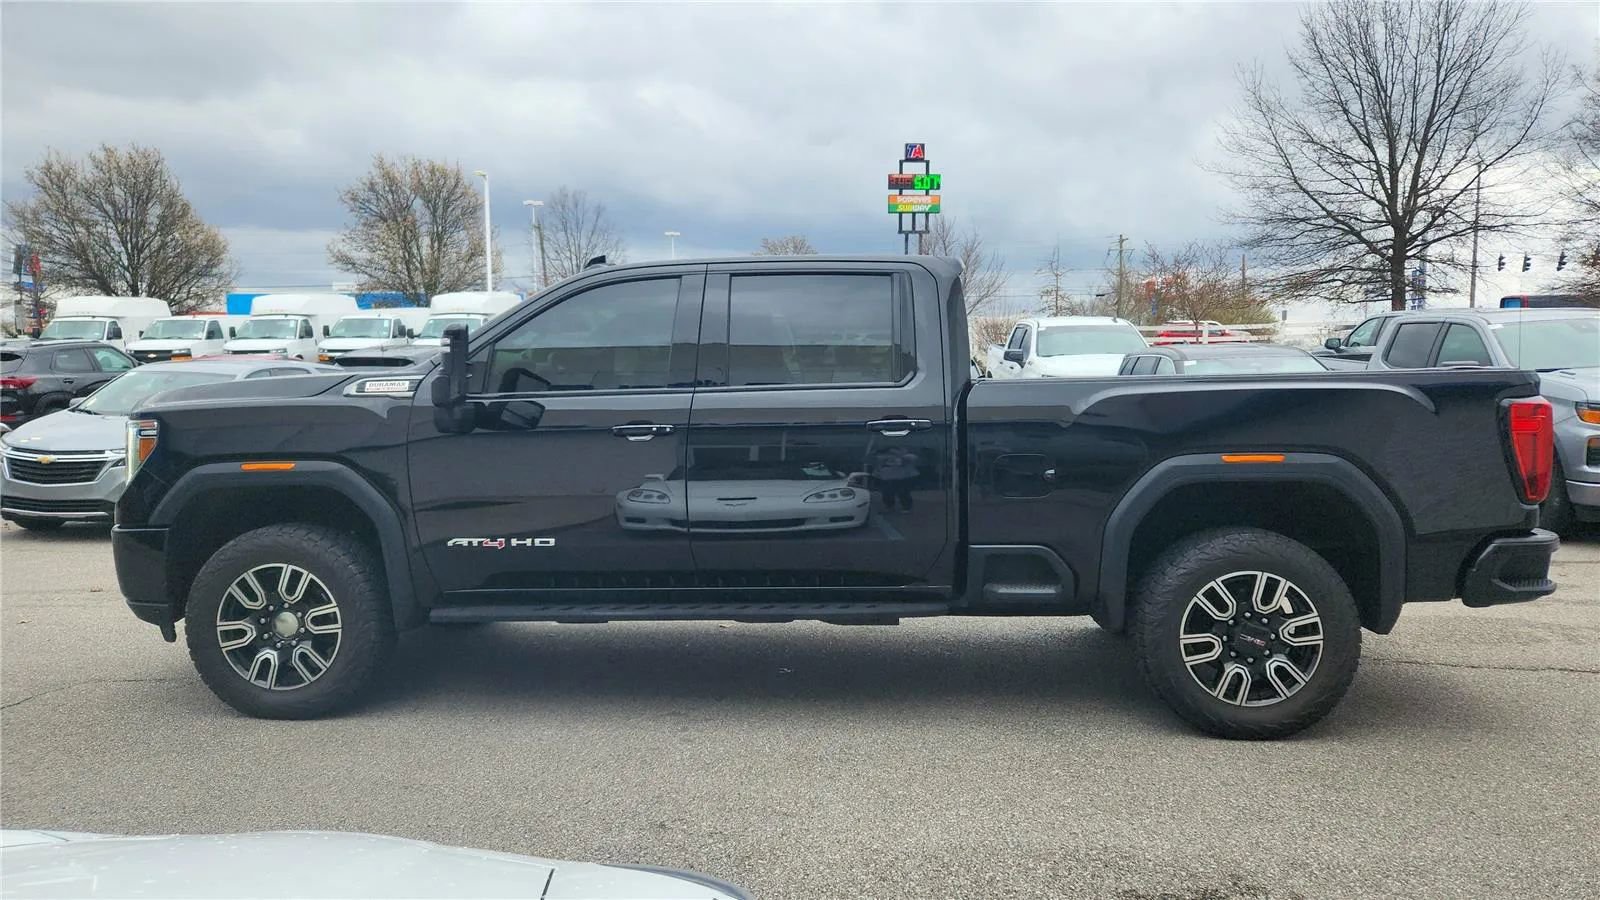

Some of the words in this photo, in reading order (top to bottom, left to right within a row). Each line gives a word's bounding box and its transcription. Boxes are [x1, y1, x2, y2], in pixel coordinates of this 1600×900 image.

[907, 143, 924, 159] TA
[447, 538, 506, 549] AT4
[511, 538, 556, 546] HD
